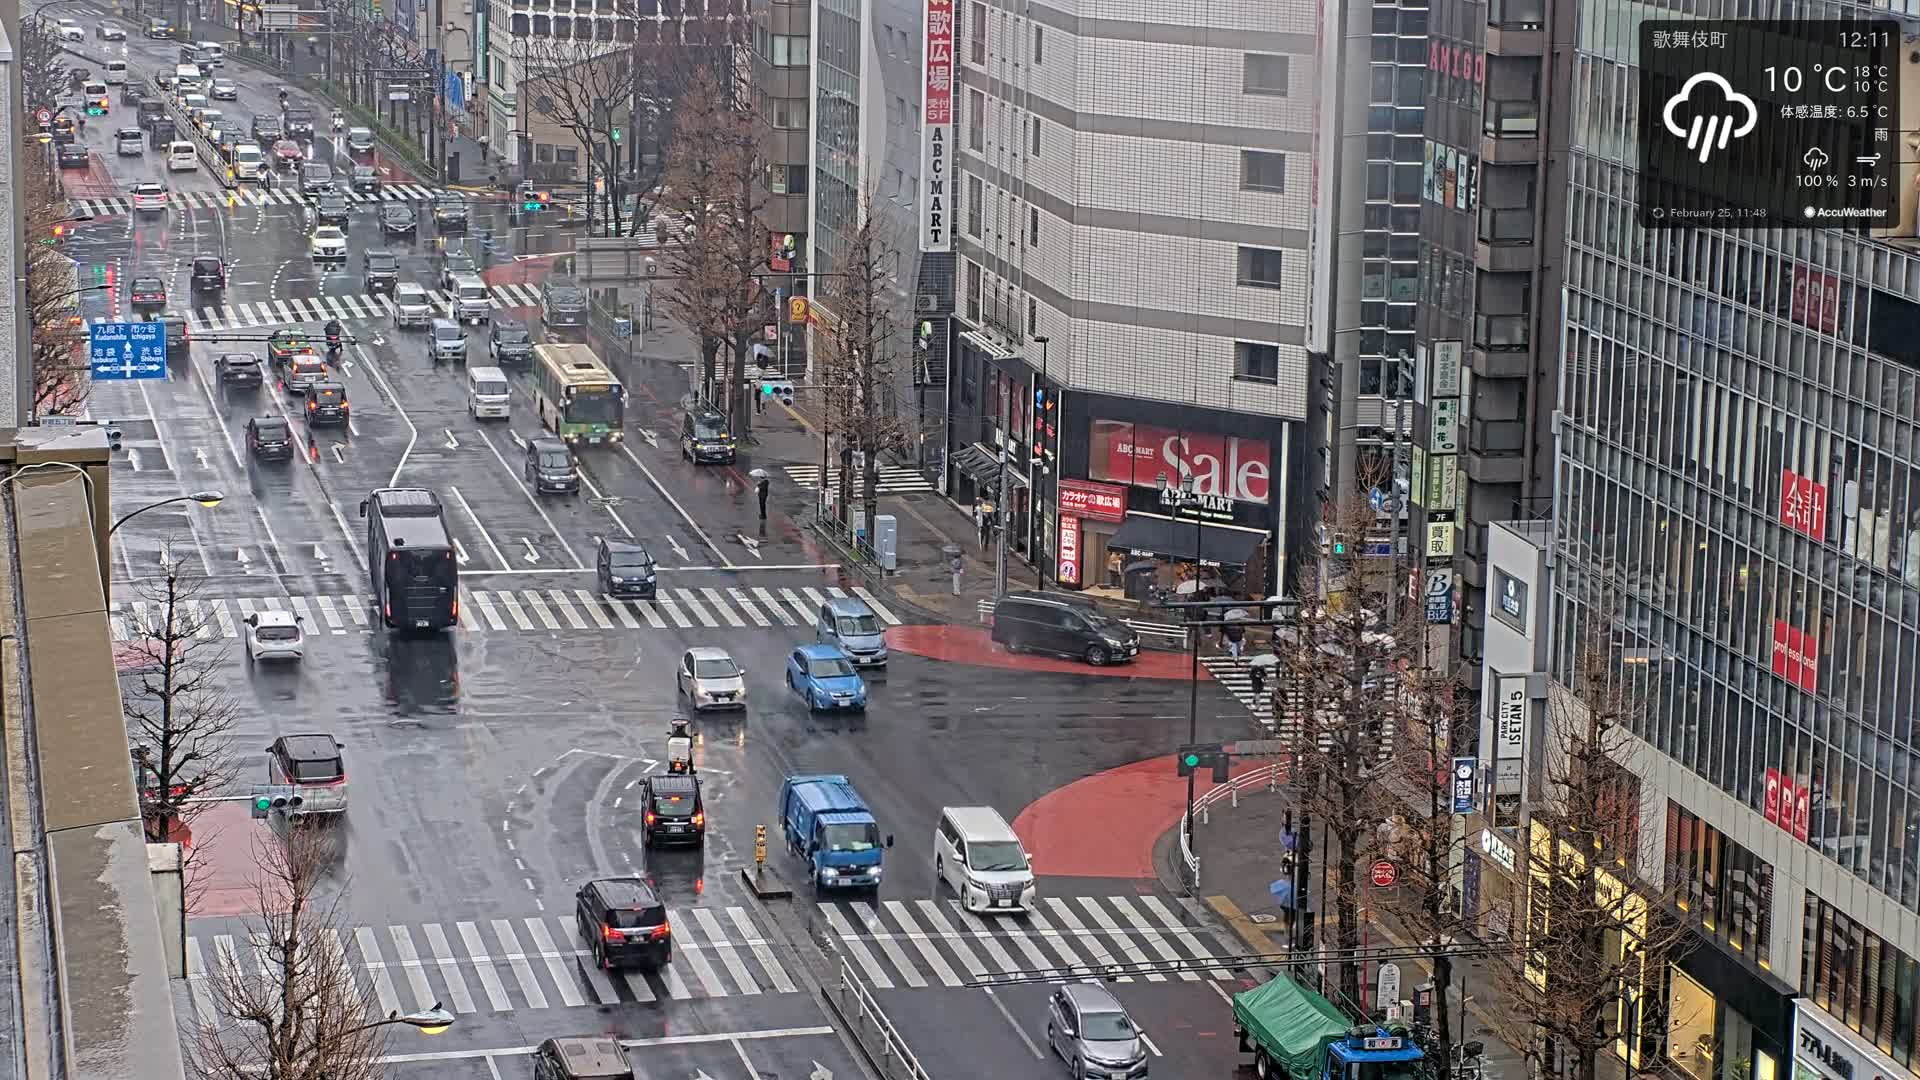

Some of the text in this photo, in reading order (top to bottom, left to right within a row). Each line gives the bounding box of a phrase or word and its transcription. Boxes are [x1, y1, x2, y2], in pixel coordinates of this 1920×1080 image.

[928, 10, 951, 91] 歌広場
[1430, 41, 1483, 82] AMIGO
[928, 98, 949, 109] 受付
[928, 110, 948, 120] 5F
[97, 325, 125, 334] 九段下
[94, 346, 162, 357] 池袋 渋谷
[1117, 443, 1154, 456] ABC-MART
[1163, 436, 1269, 501] Sale
[1786, 482, 1822, 530] 会計
[1431, 526, 1444, 553] 買取
[1199, 559, 1221, 567] BC-MART
[1428, 610, 1448, 620] BiZ
[1774, 640, 1818, 671] professional
[1501, 701, 1510, 739] PARK CITY
[1509, 690, 1524, 745] ISETAN 5
[1767, 779, 1806, 827] CPA
